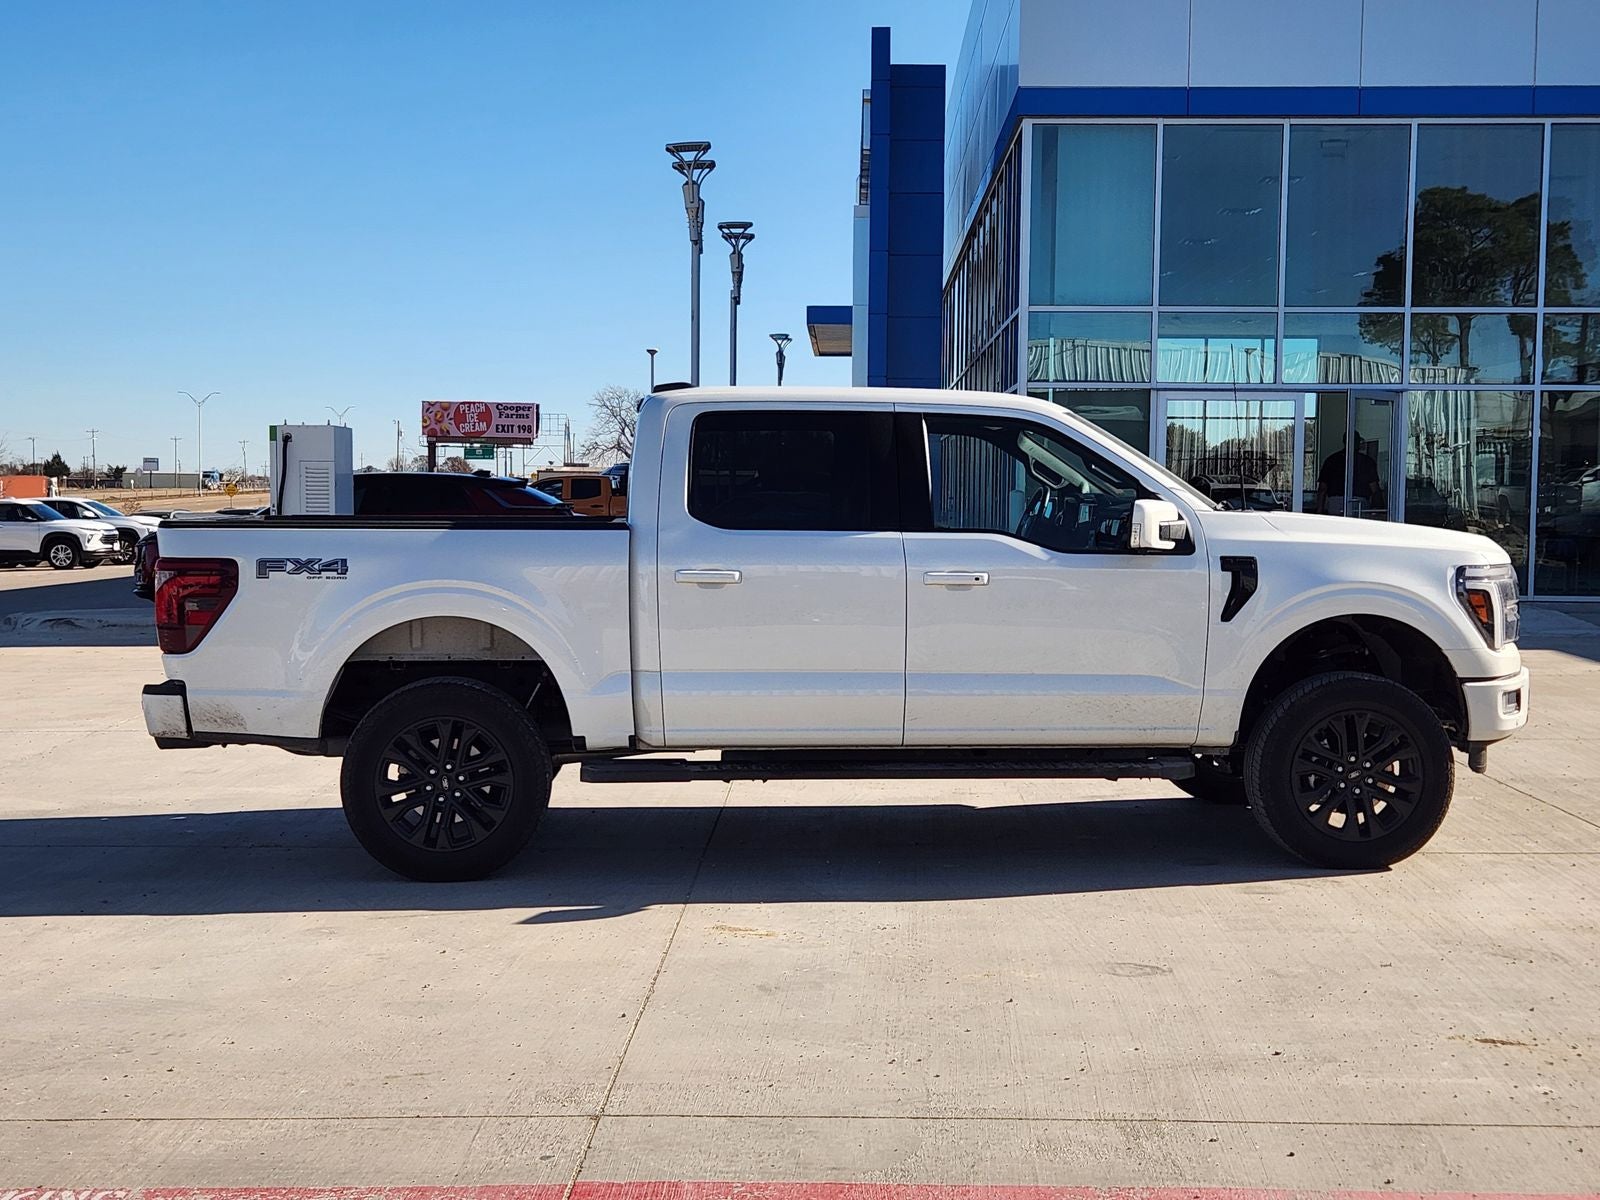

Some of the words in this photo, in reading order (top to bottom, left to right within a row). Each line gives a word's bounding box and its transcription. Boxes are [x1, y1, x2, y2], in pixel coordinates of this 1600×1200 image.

[460, 403, 486, 414] PEACH
[496, 403, 532, 413] Cooper
[466, 413, 479, 422] ICE
[499, 411, 530, 419] Farms
[459, 422, 487, 433] CREAM
[495, 424, 515, 434] EXIT
[517, 424, 532, 434] 198
[256, 557, 349, 579] FX4
